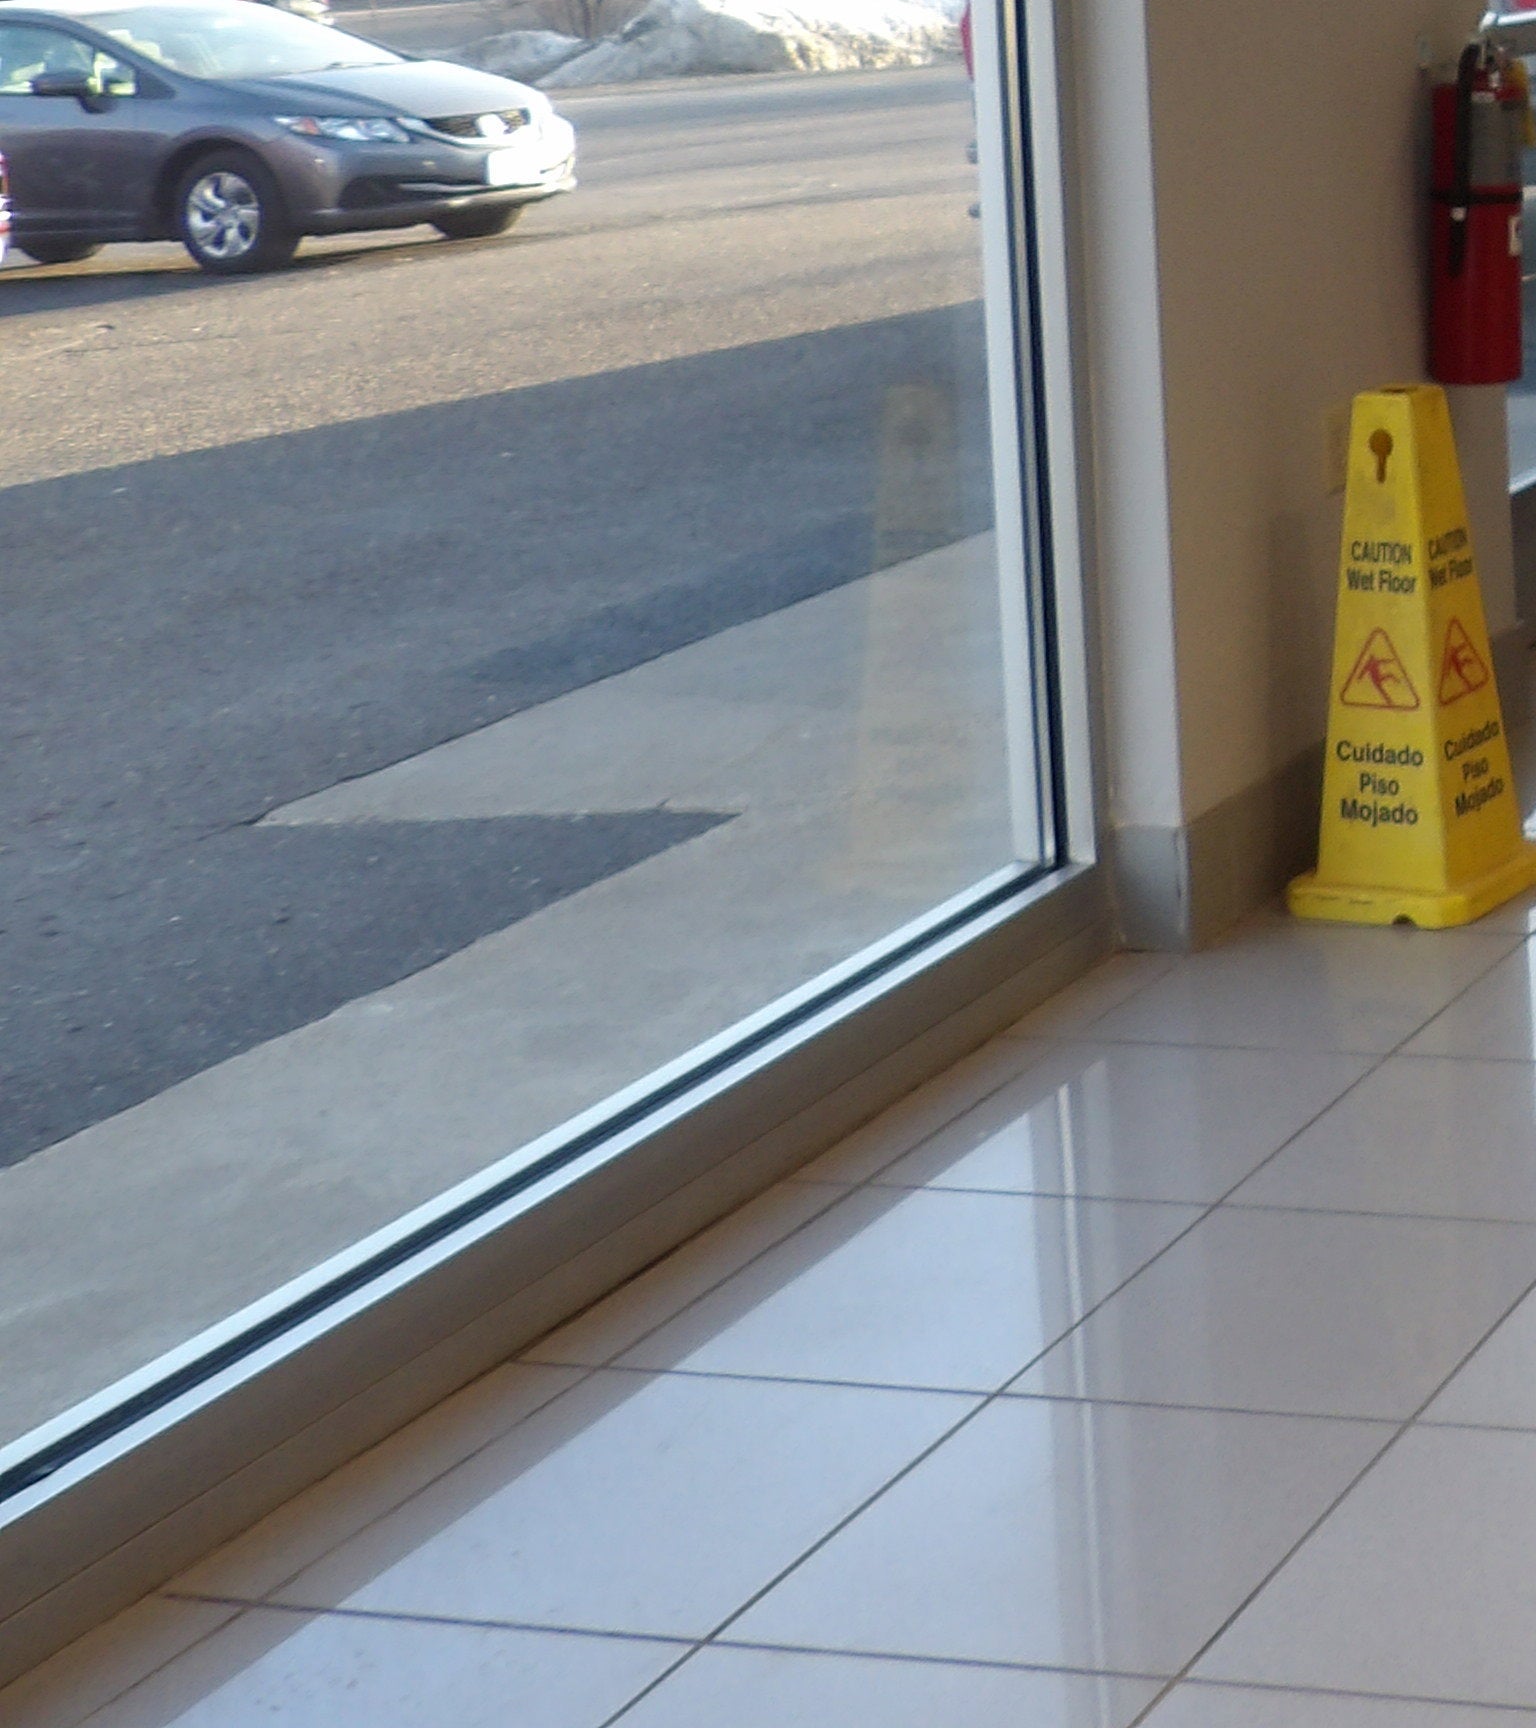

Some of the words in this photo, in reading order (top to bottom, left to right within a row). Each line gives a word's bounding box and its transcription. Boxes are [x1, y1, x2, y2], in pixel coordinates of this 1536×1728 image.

[1351, 540, 1412, 564] CAUTION
[1347, 567, 1374, 592] Wet
[1378, 569, 1416, 594] Floor
[1336, 740, 1424, 767] Cuidado
[1360, 772, 1399, 796] Piso
[1340, 798, 1418, 827] Mojado
